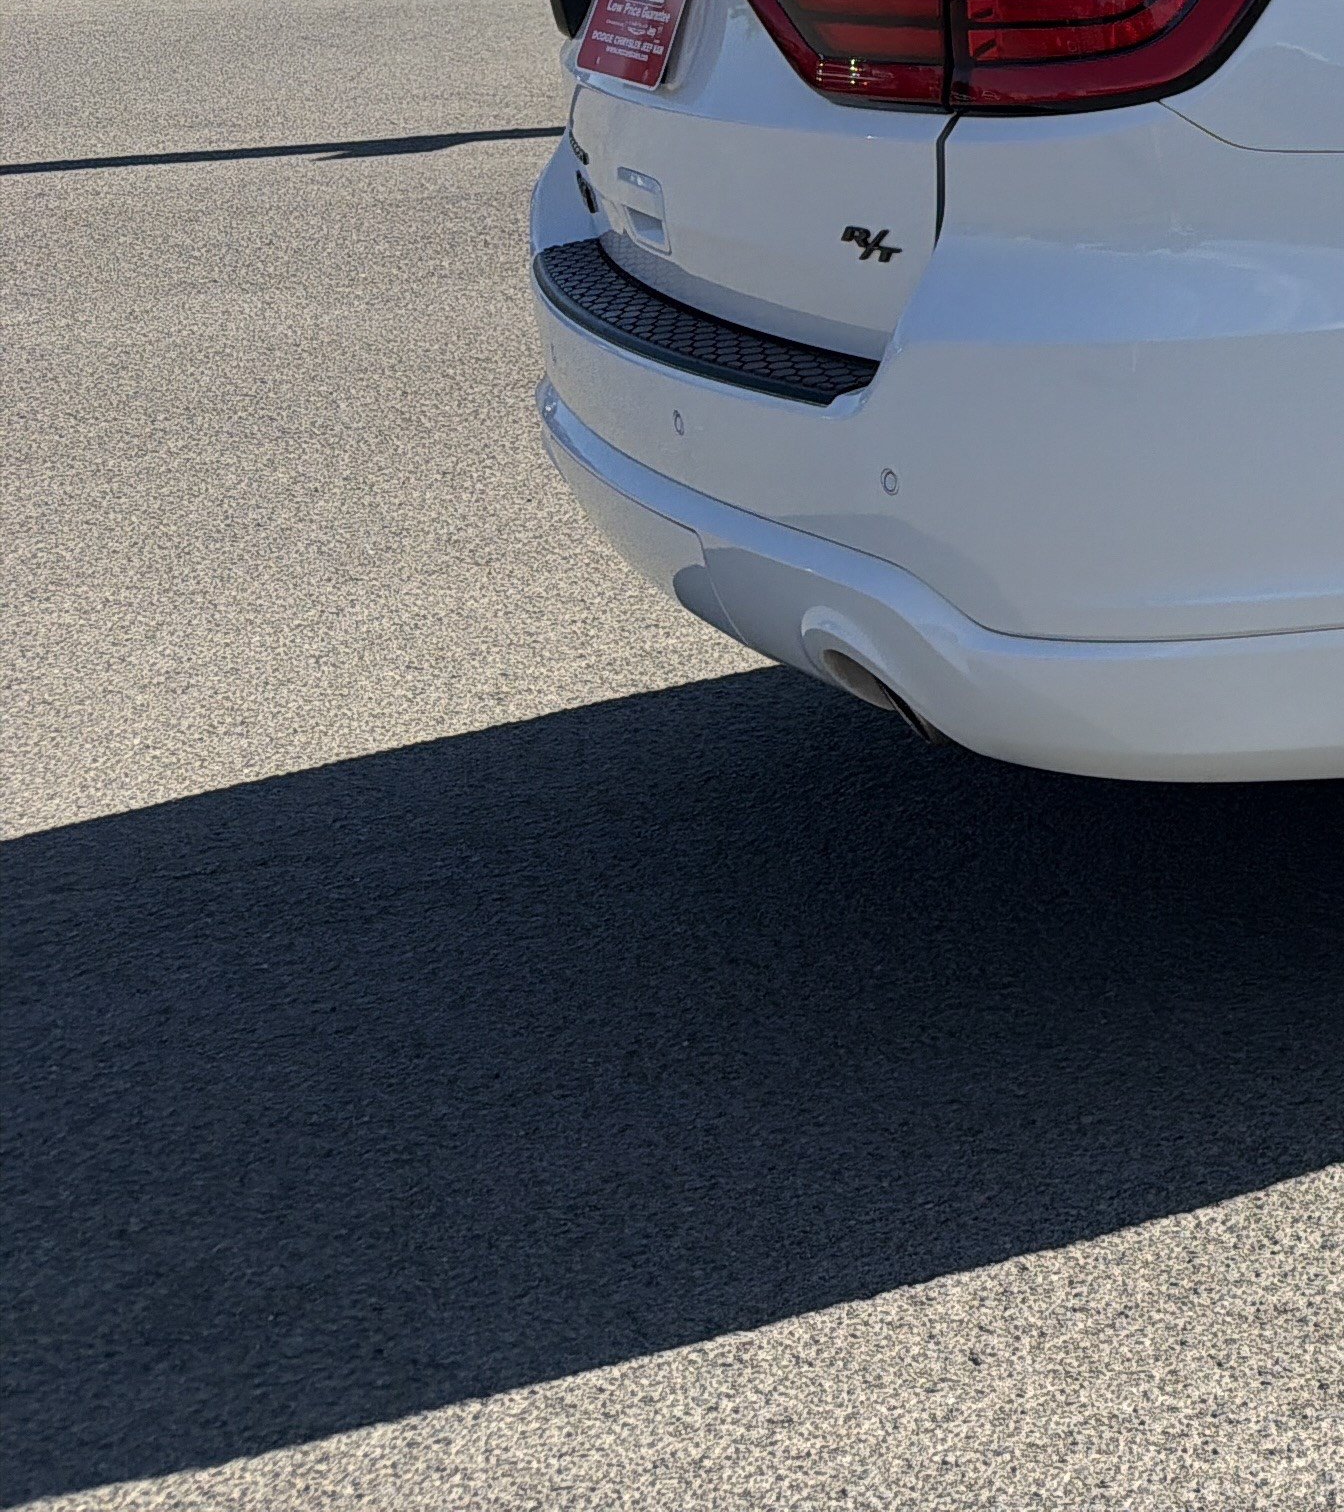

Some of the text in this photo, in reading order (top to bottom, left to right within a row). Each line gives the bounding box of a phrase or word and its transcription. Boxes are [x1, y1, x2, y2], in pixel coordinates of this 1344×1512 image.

[607, 0, 622, 14] Low
[624, 2, 641, 16] Price
[592, 30, 614, 44] DODGE
[841, 225, 903, 263] R/T
